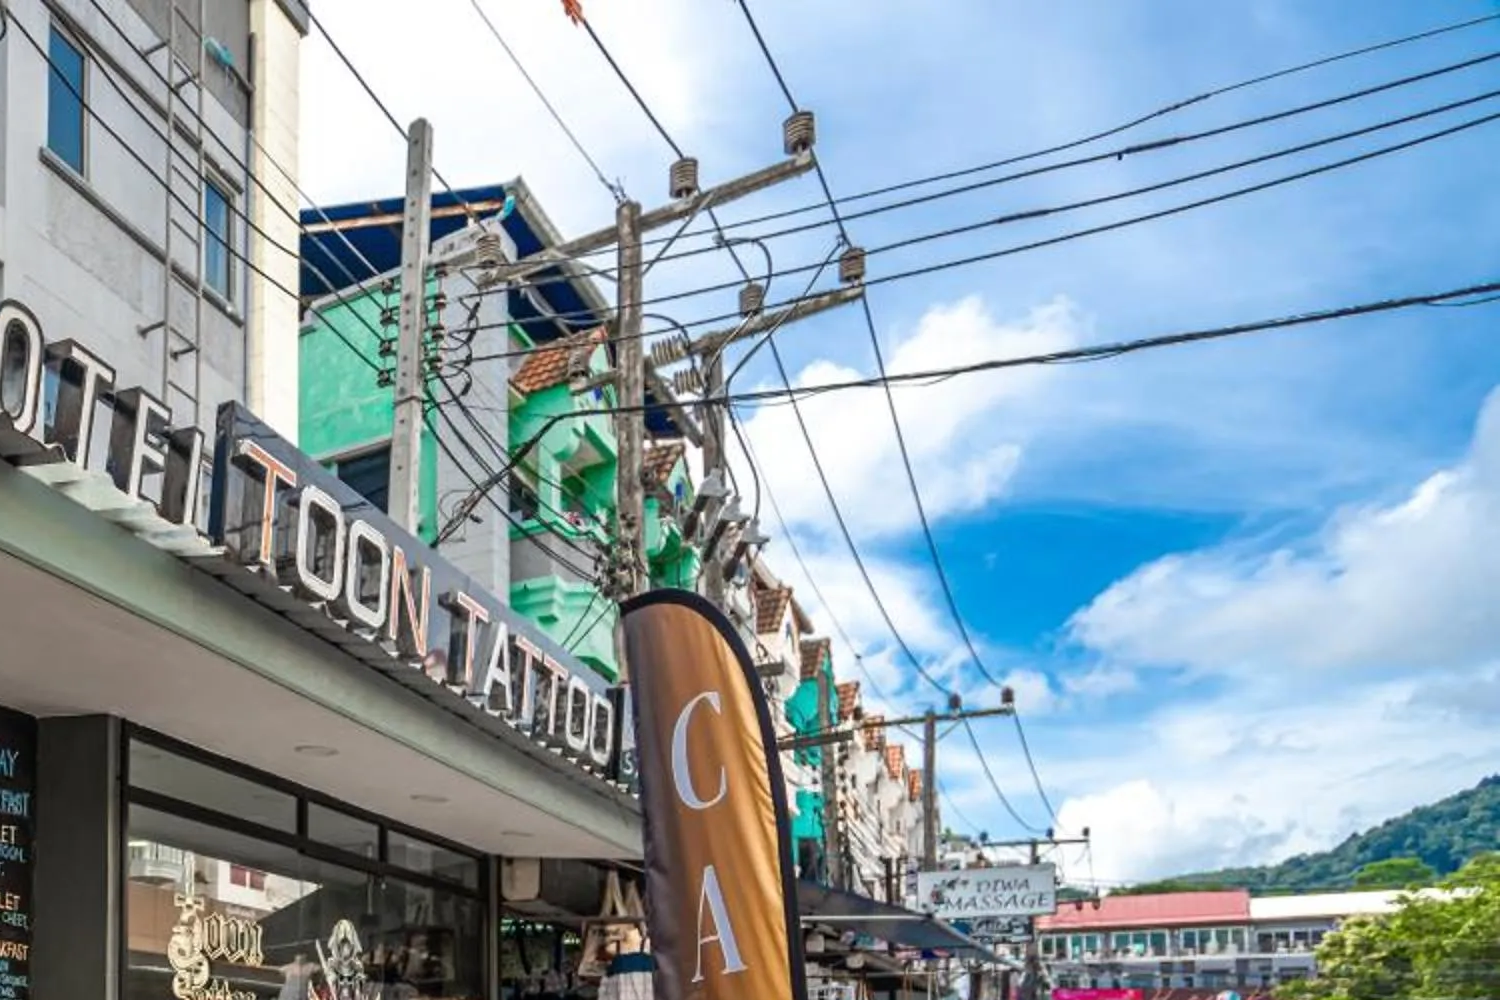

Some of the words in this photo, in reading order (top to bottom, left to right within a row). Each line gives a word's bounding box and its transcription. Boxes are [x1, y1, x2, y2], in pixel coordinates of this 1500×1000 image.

[238, 440, 431, 657] TOON
[450, 592, 615, 765] TATTOO
[976, 878, 1031, 893] DIWA
[946, 892, 1050, 911] MASSAGE
